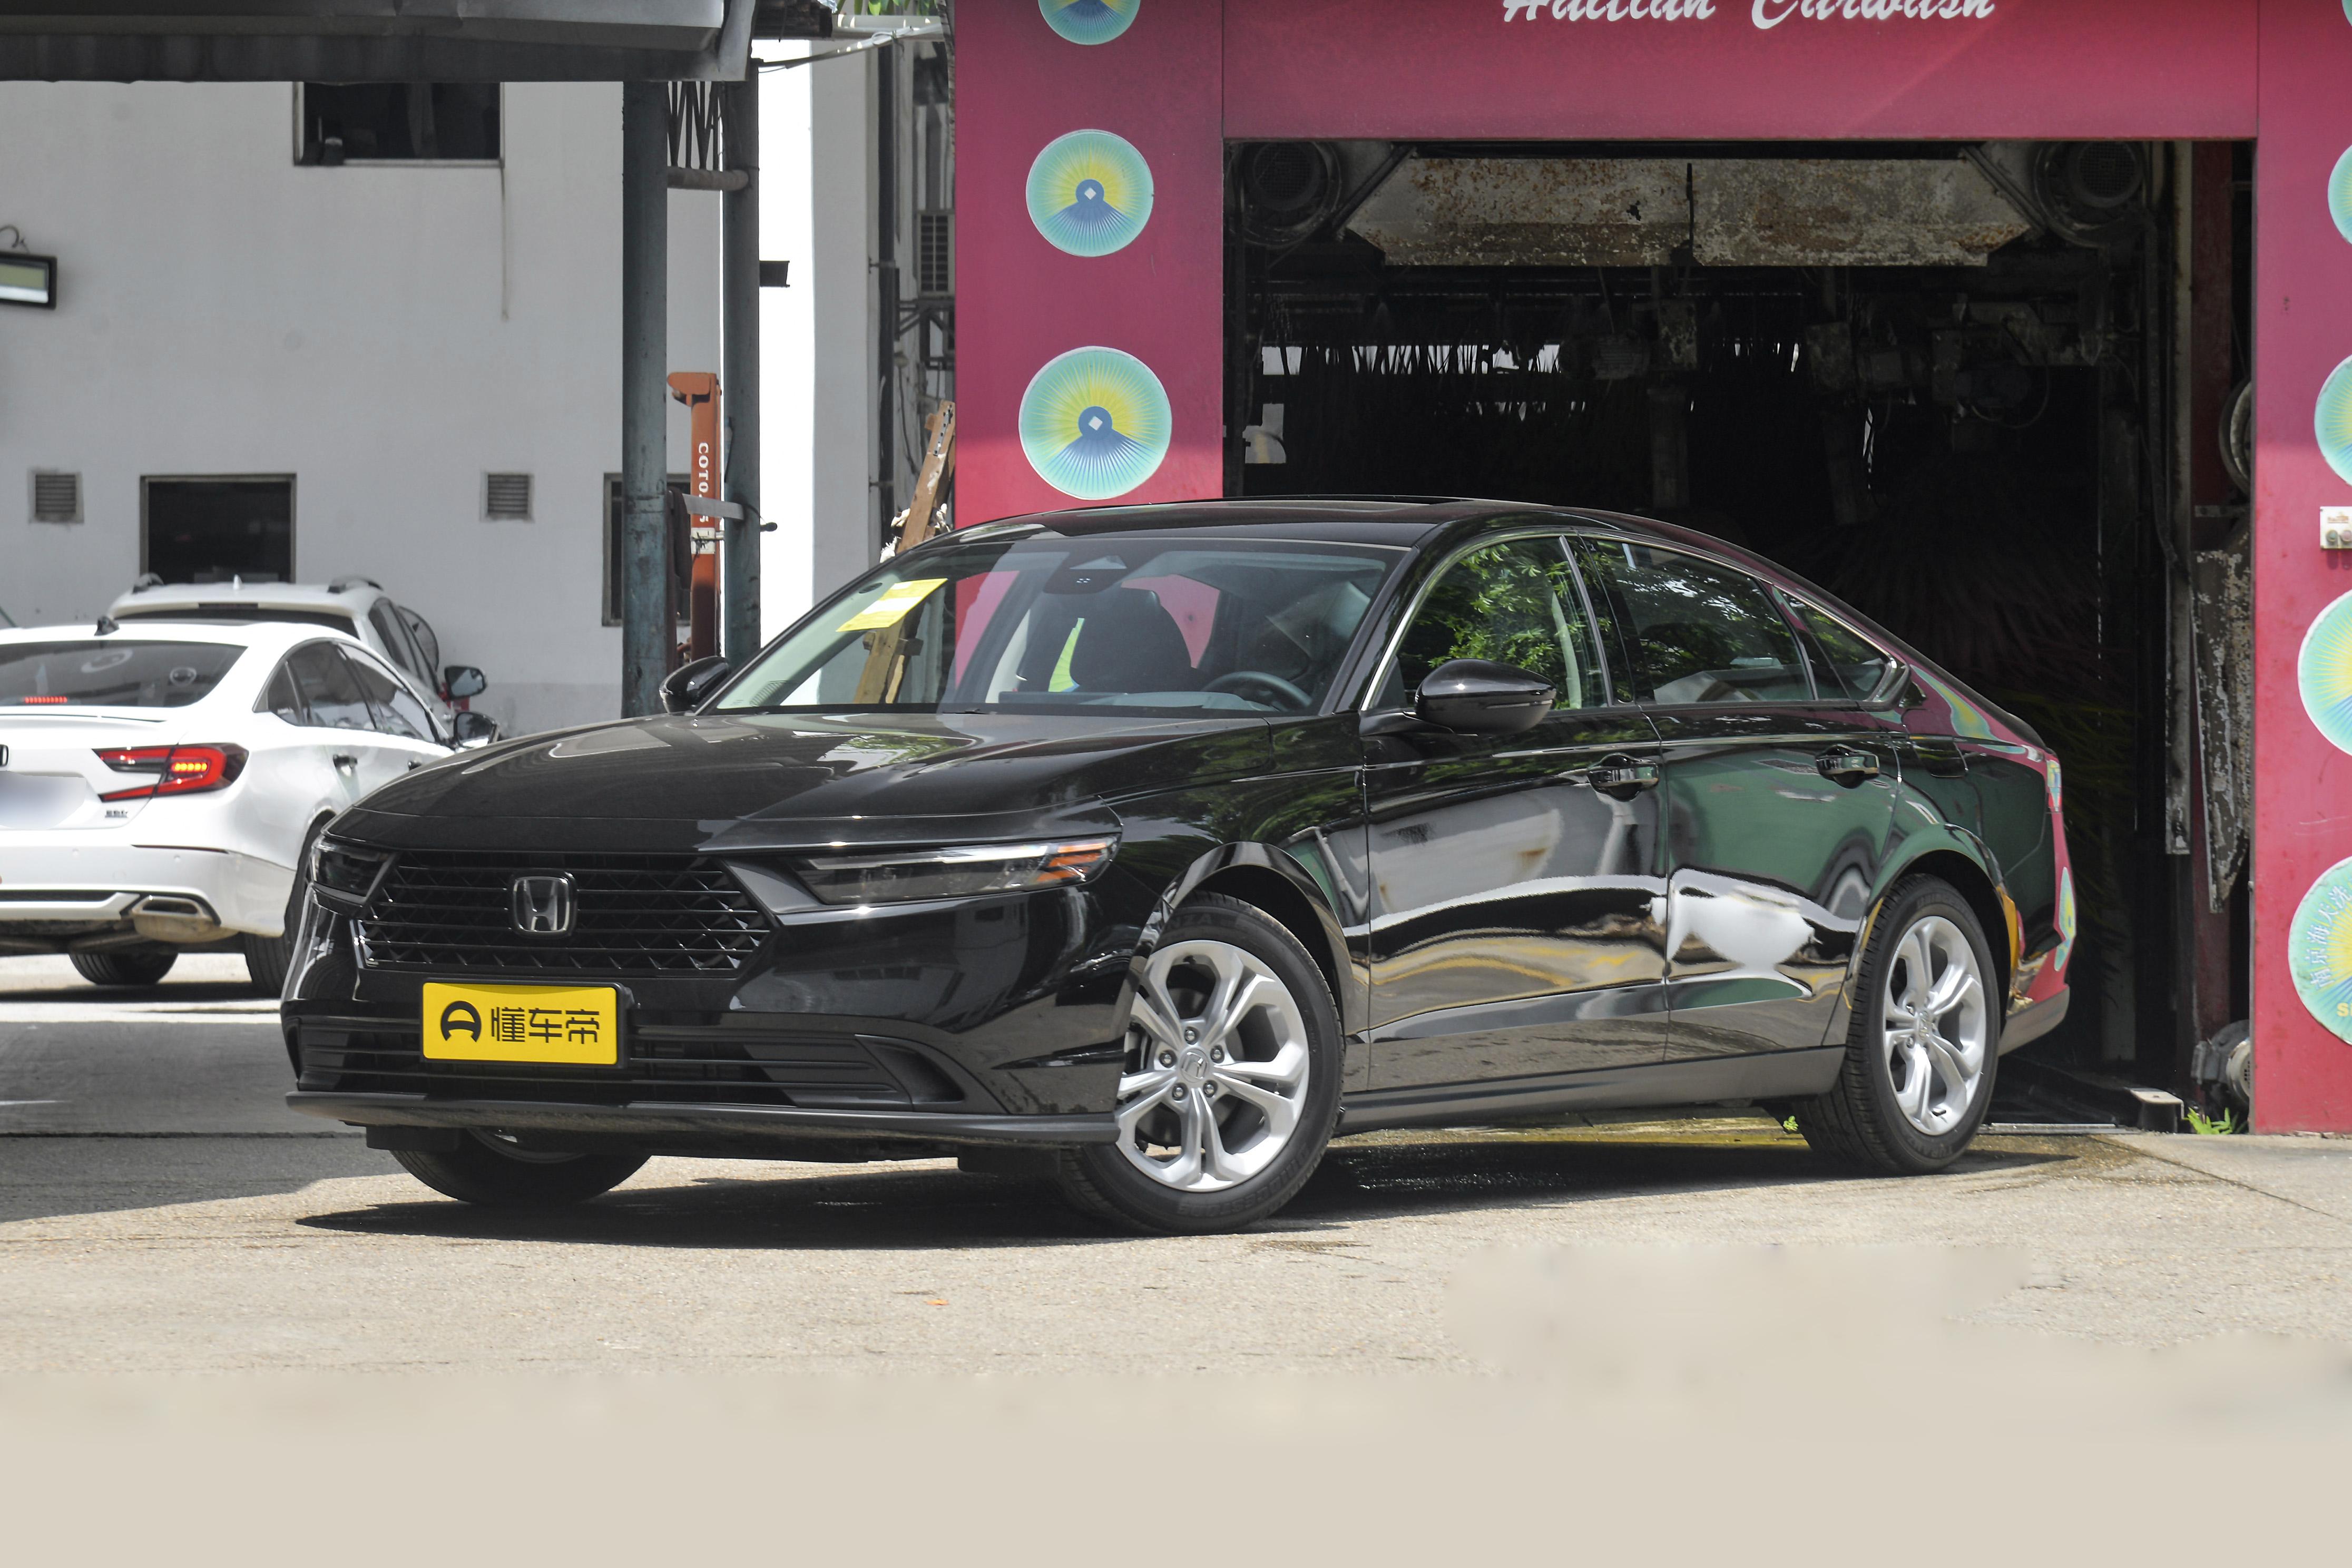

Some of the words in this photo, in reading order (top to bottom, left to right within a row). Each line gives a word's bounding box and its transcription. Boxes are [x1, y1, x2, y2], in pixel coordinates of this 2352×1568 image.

[2337, 1002, 2352, 1017] S
[491, 1006, 600, 1045] 懂车帝
